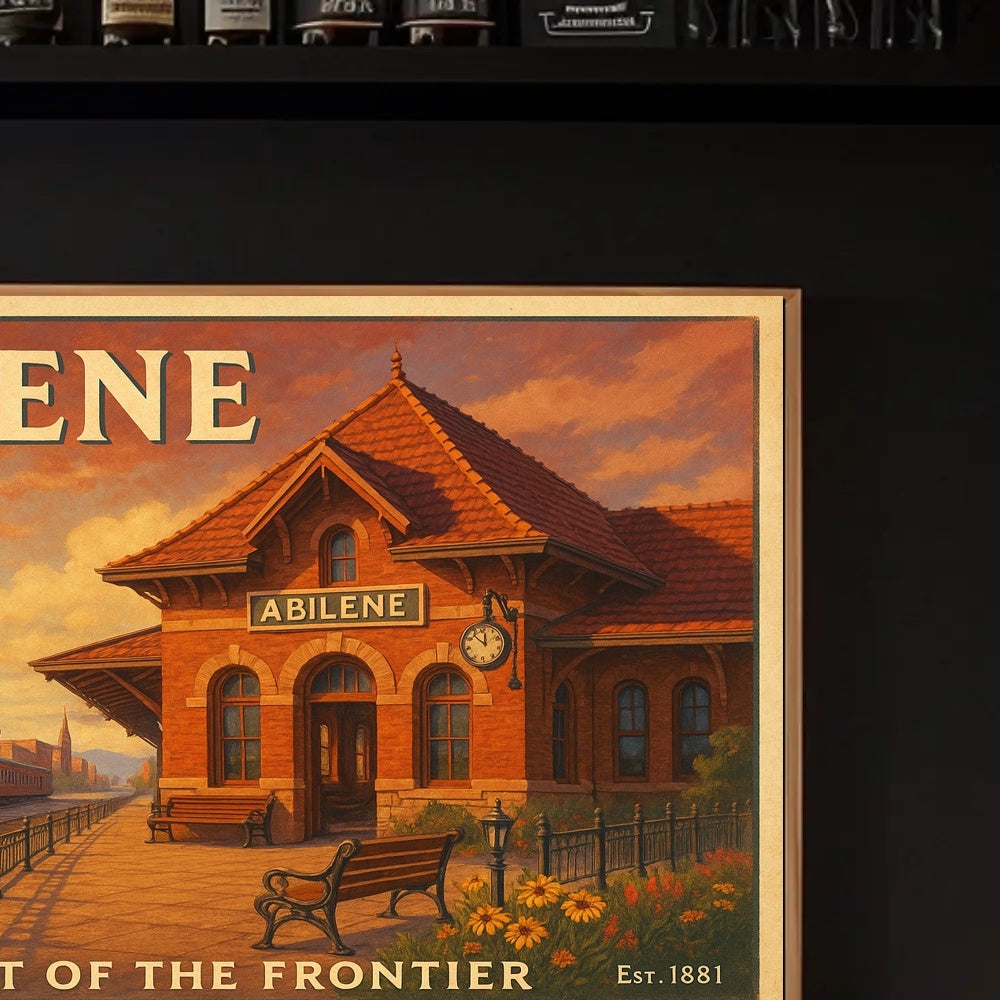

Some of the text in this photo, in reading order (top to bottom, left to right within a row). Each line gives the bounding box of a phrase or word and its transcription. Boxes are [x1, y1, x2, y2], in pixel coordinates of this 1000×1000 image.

[260, 593, 405, 622] ABILENE
[46, 960, 113, 991] OF
[135, 960, 238, 991] THE
[262, 960, 533, 991] FRONTIER
